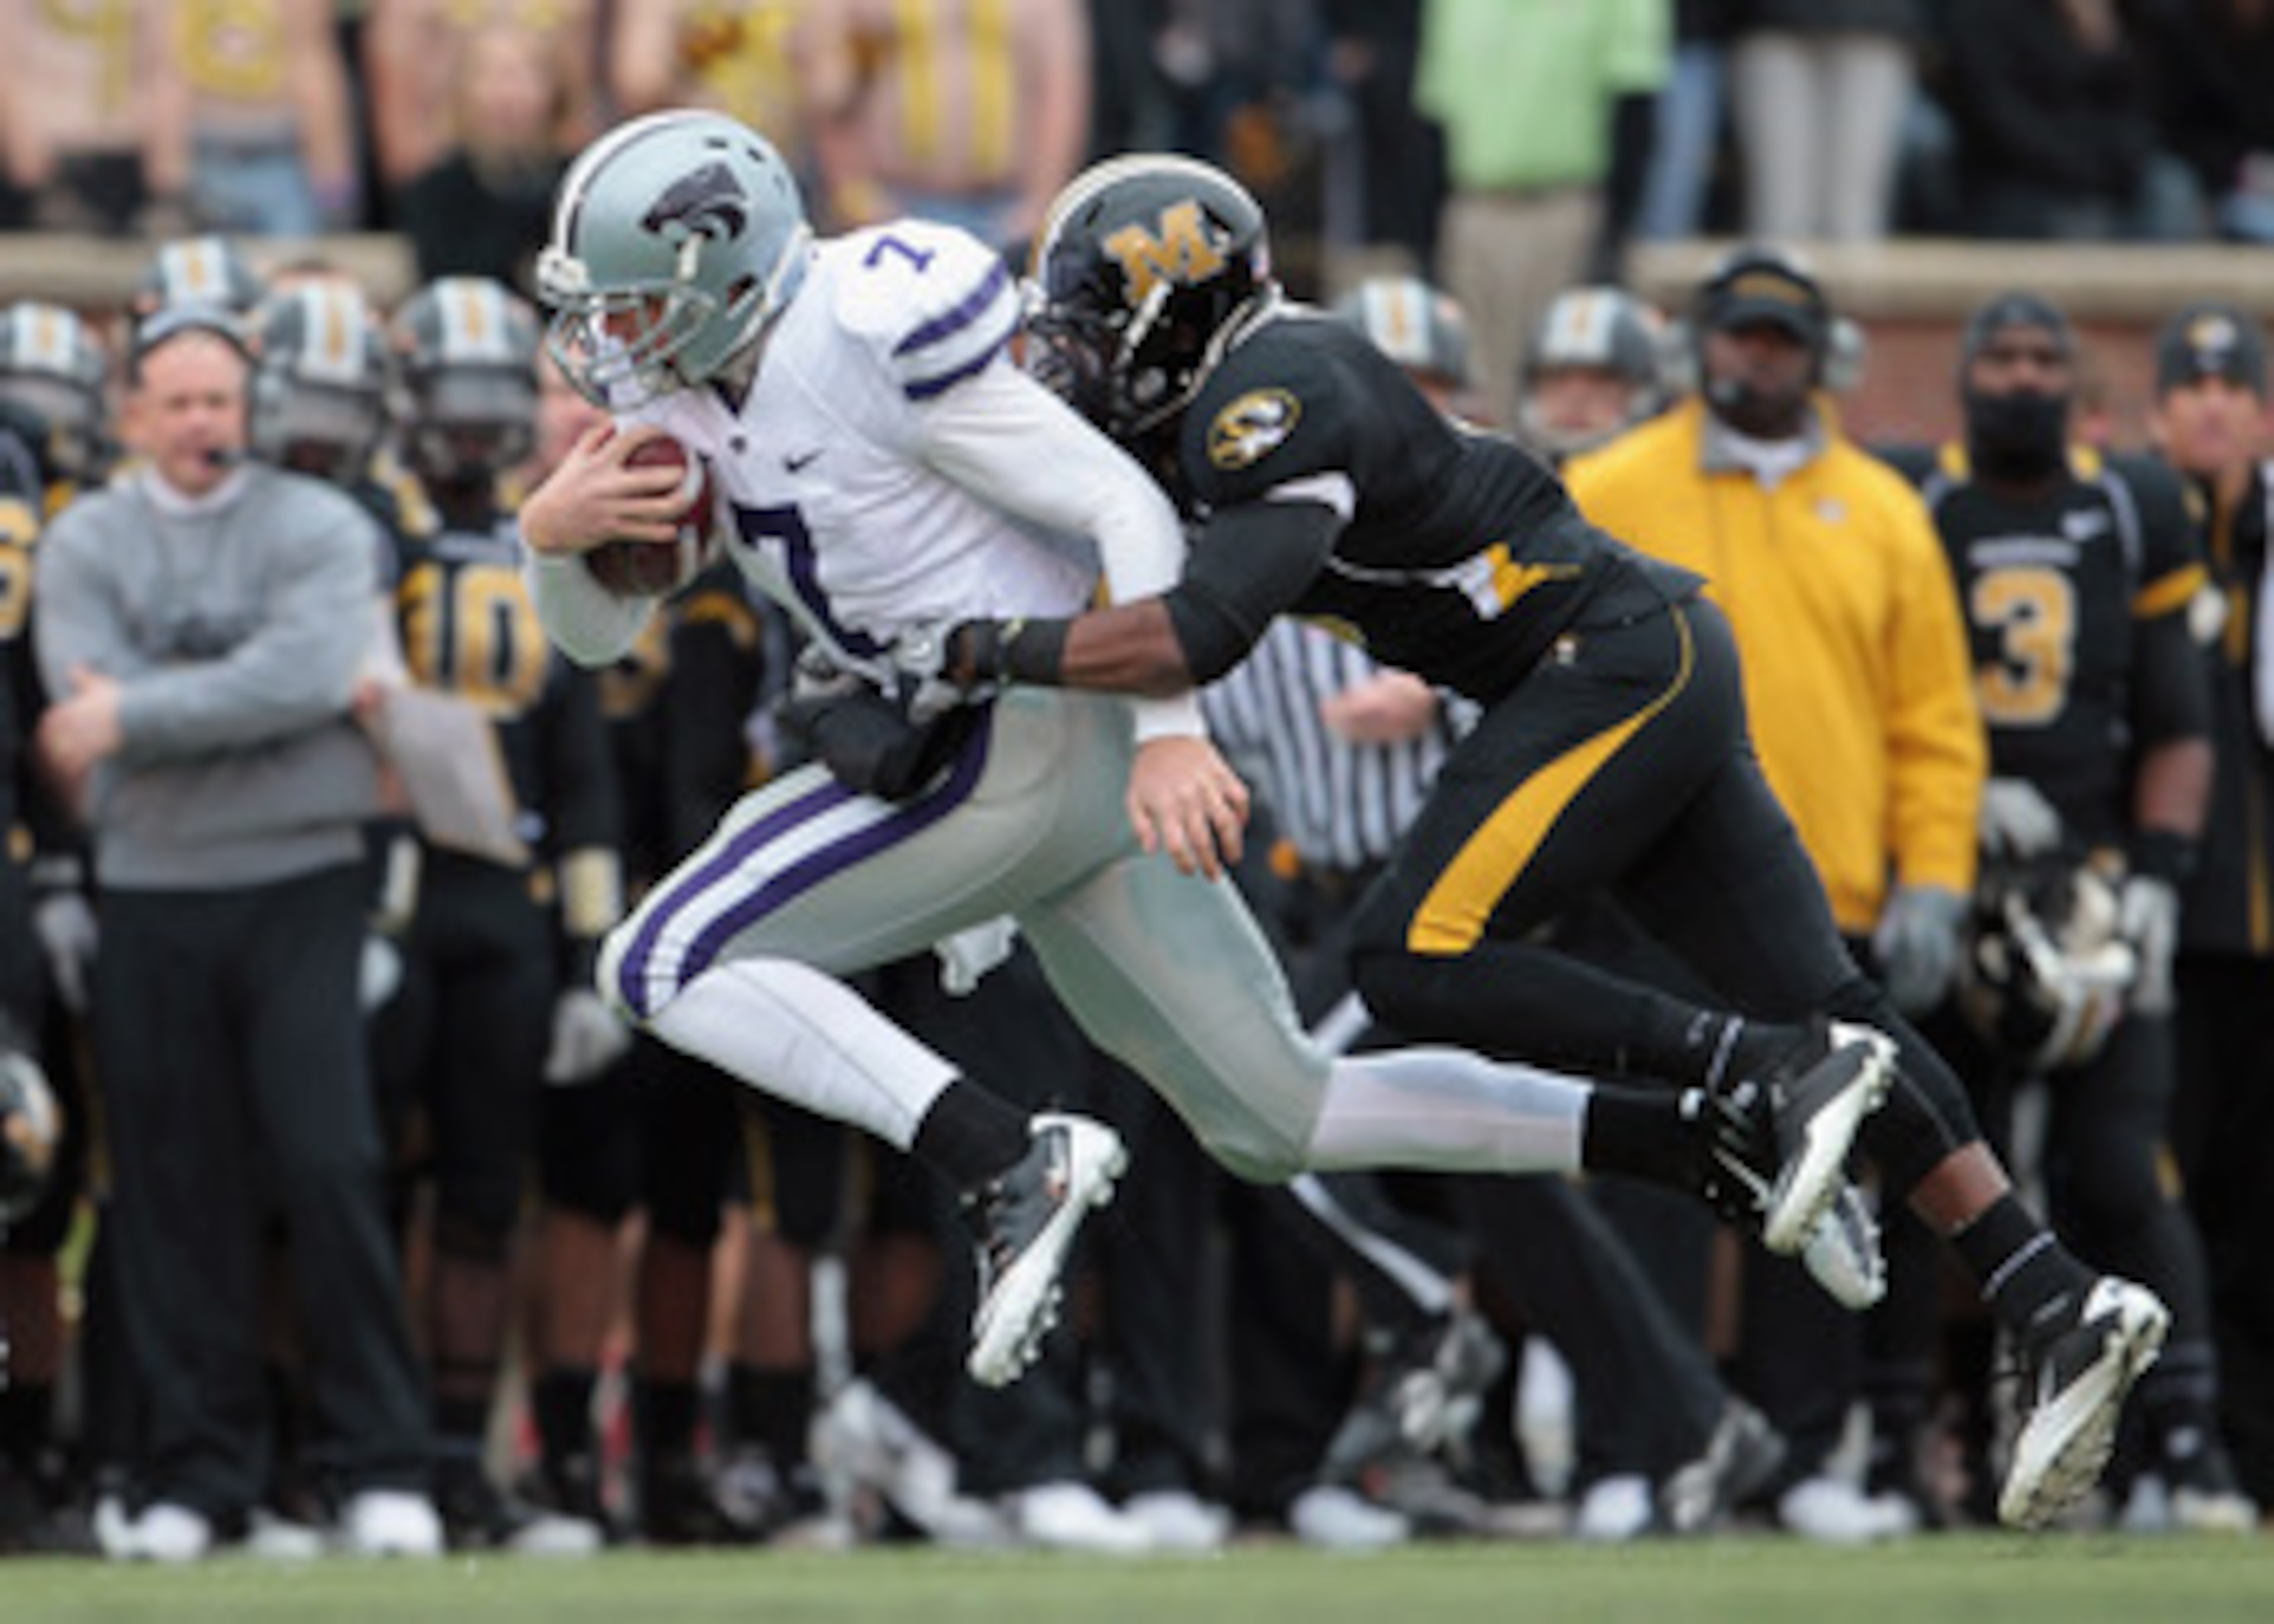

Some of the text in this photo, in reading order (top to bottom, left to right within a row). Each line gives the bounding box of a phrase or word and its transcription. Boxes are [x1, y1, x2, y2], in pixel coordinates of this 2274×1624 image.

[862, 234, 937, 274] 7
[1103, 198, 1227, 309] M
[394, 561, 550, 721] 10
[727, 501, 900, 658] 7
[1971, 566, 2077, 729] 3
